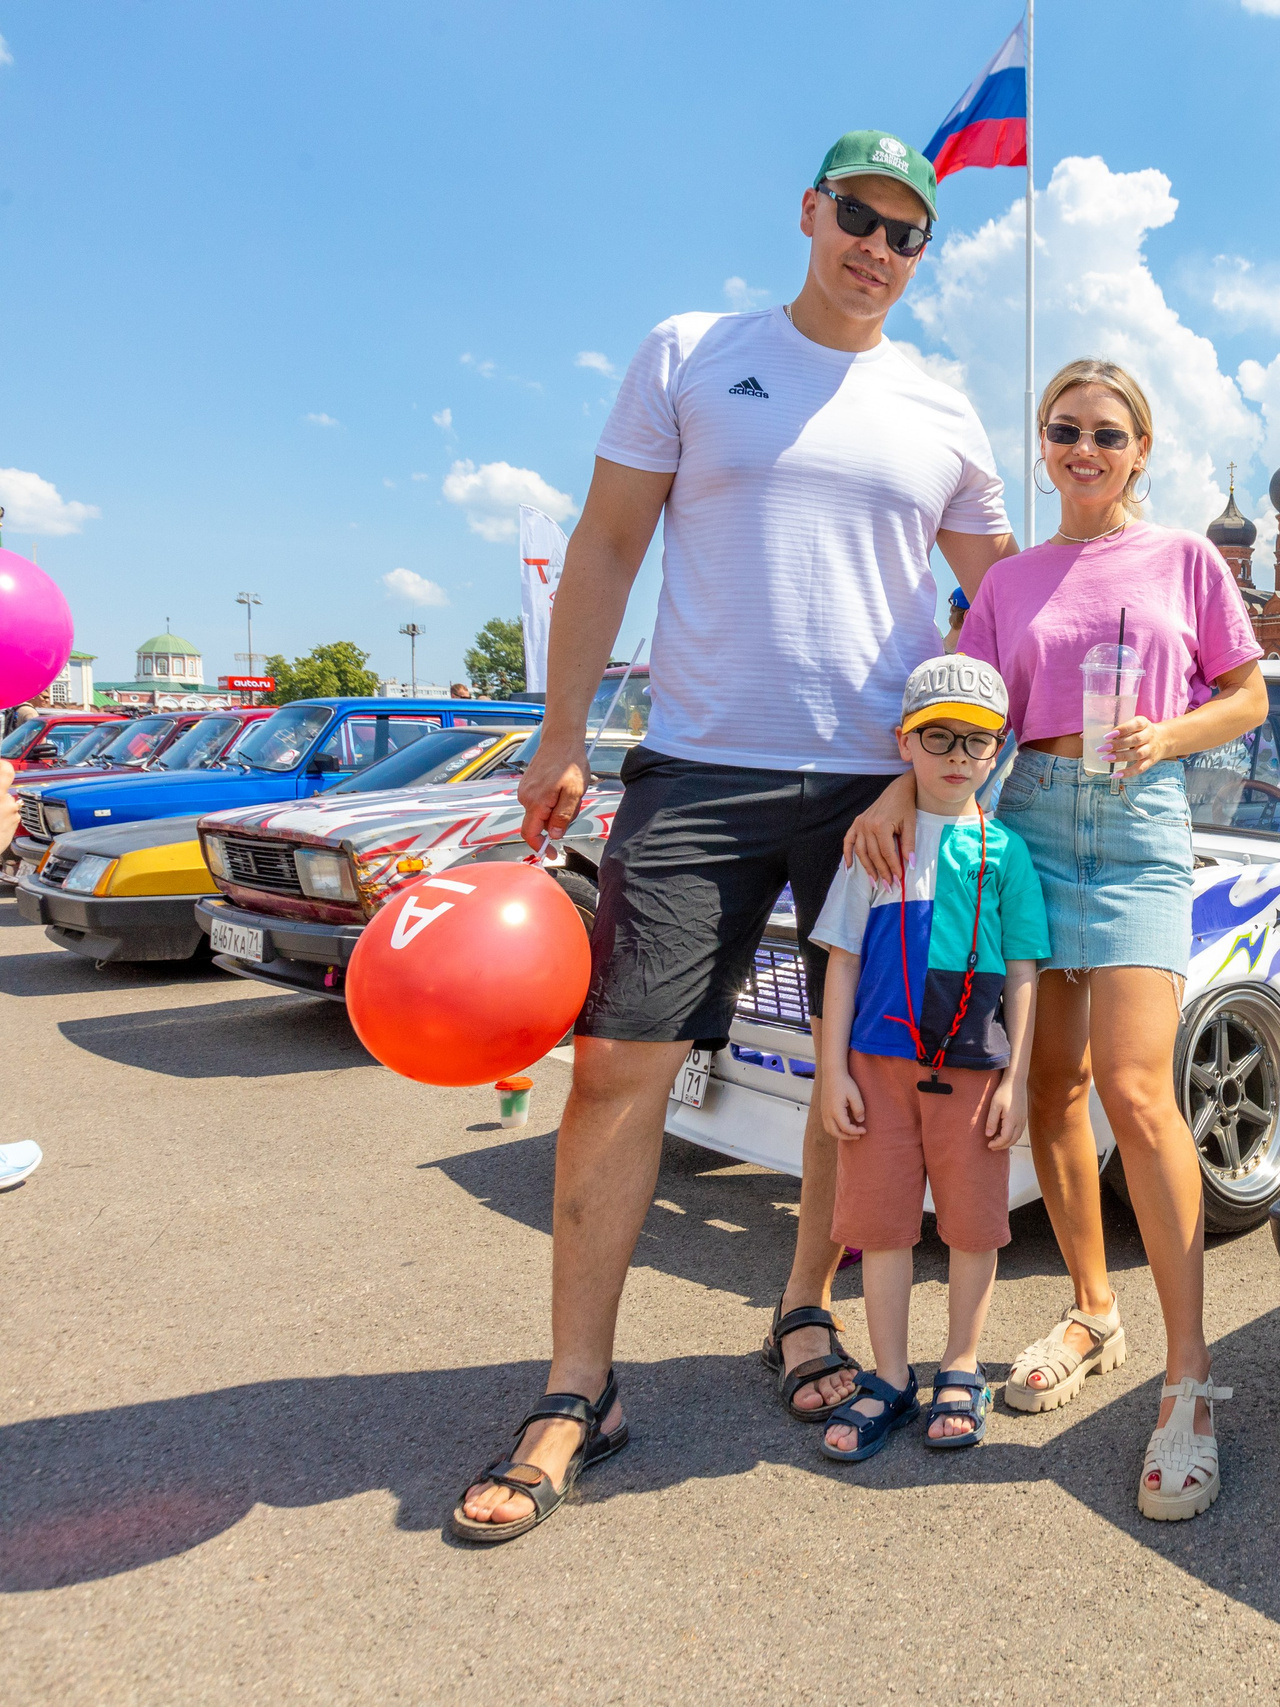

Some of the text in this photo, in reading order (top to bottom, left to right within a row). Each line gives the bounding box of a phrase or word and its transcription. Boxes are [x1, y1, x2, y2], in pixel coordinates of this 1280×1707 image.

[728, 387, 769, 399] adidas
[233, 680, 271, 688] auto.ru
[249, 931, 259, 951] 71
[687, 1072, 701, 1095] 71
